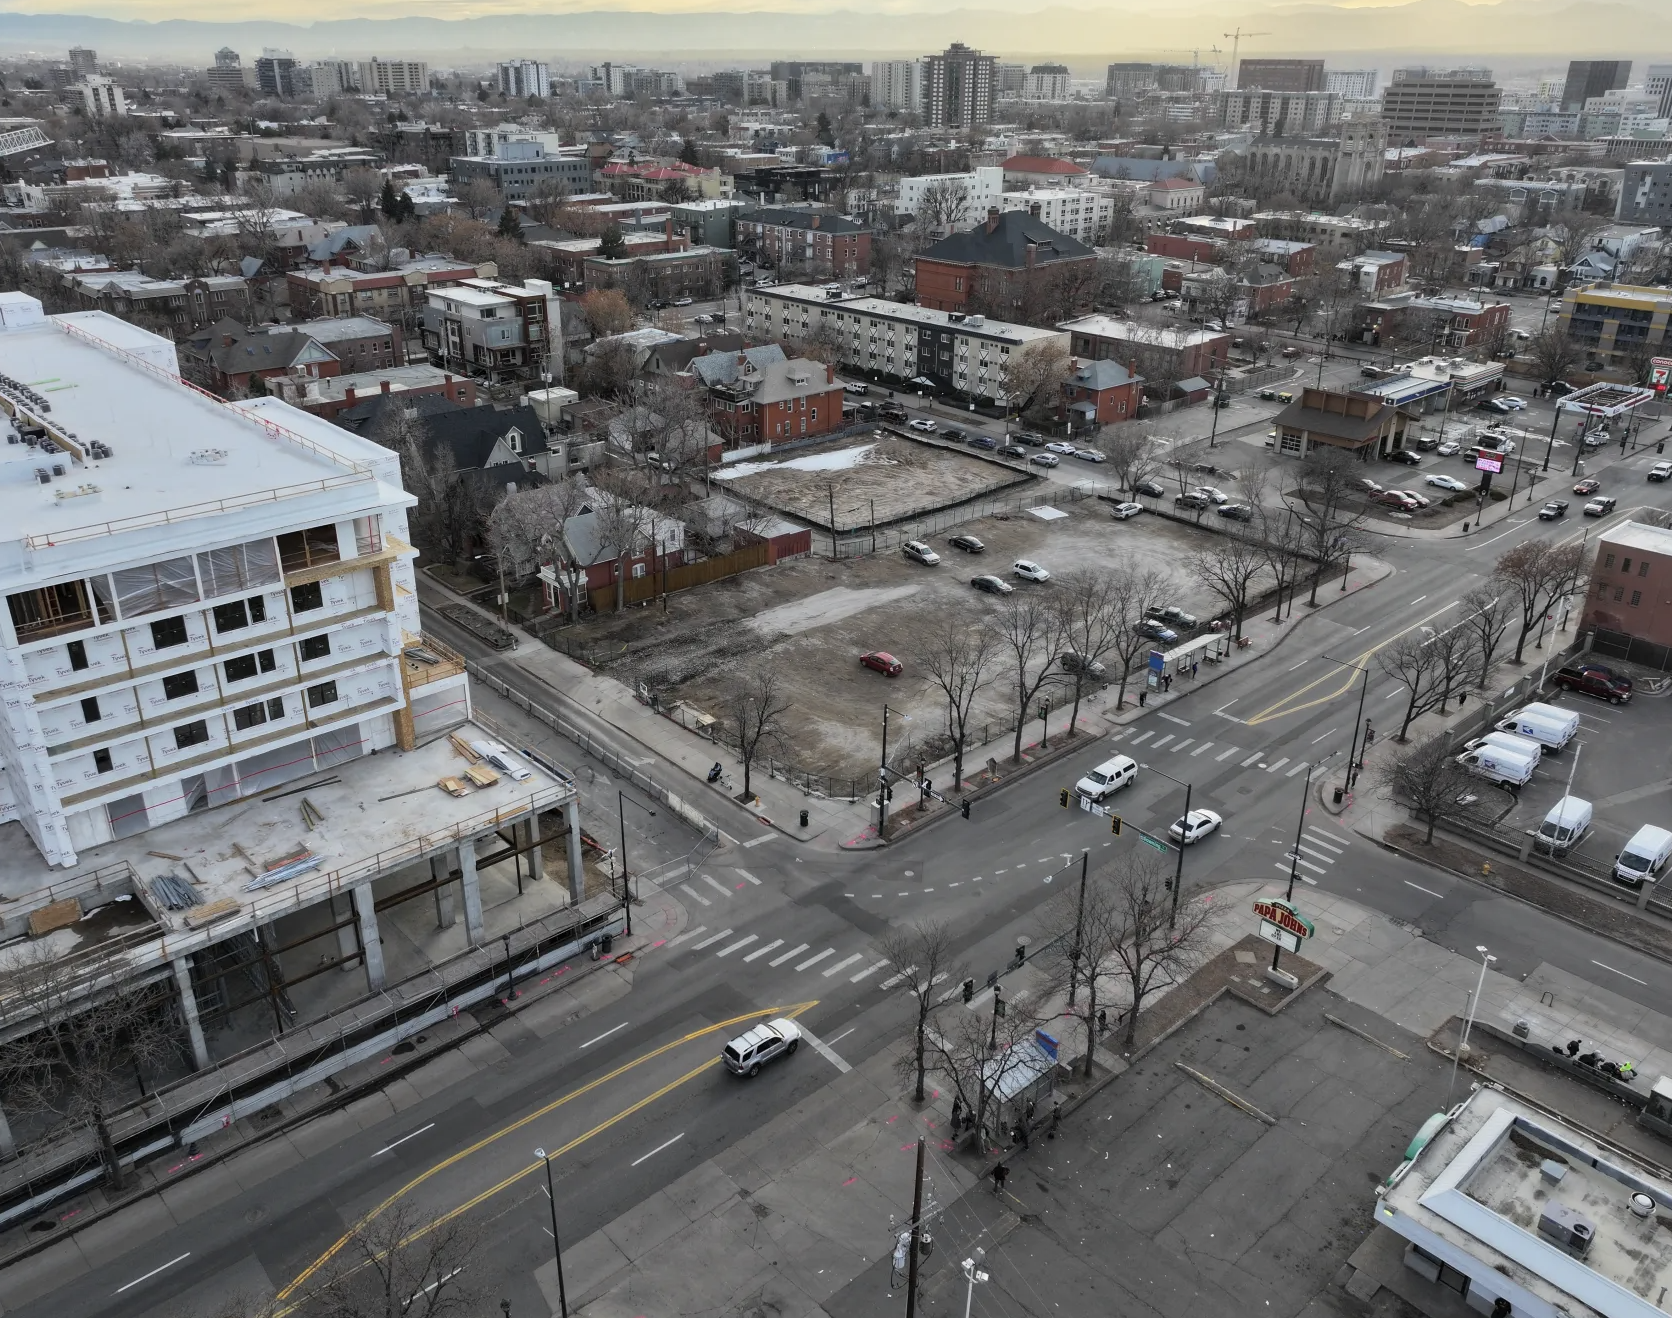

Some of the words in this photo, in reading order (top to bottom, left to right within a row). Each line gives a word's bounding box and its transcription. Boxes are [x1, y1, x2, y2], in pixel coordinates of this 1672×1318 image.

[189, 634, 205, 642] Tyvek
[138, 647, 154, 655] Tyvek
[28, 674, 46, 683] Tyvek
[42, 727, 60, 736] Tyvek
[56, 778, 73, 787] Tyvek
[1254, 904, 1276, 922] PAPA
[1278, 912, 1307, 937] JOHNS
